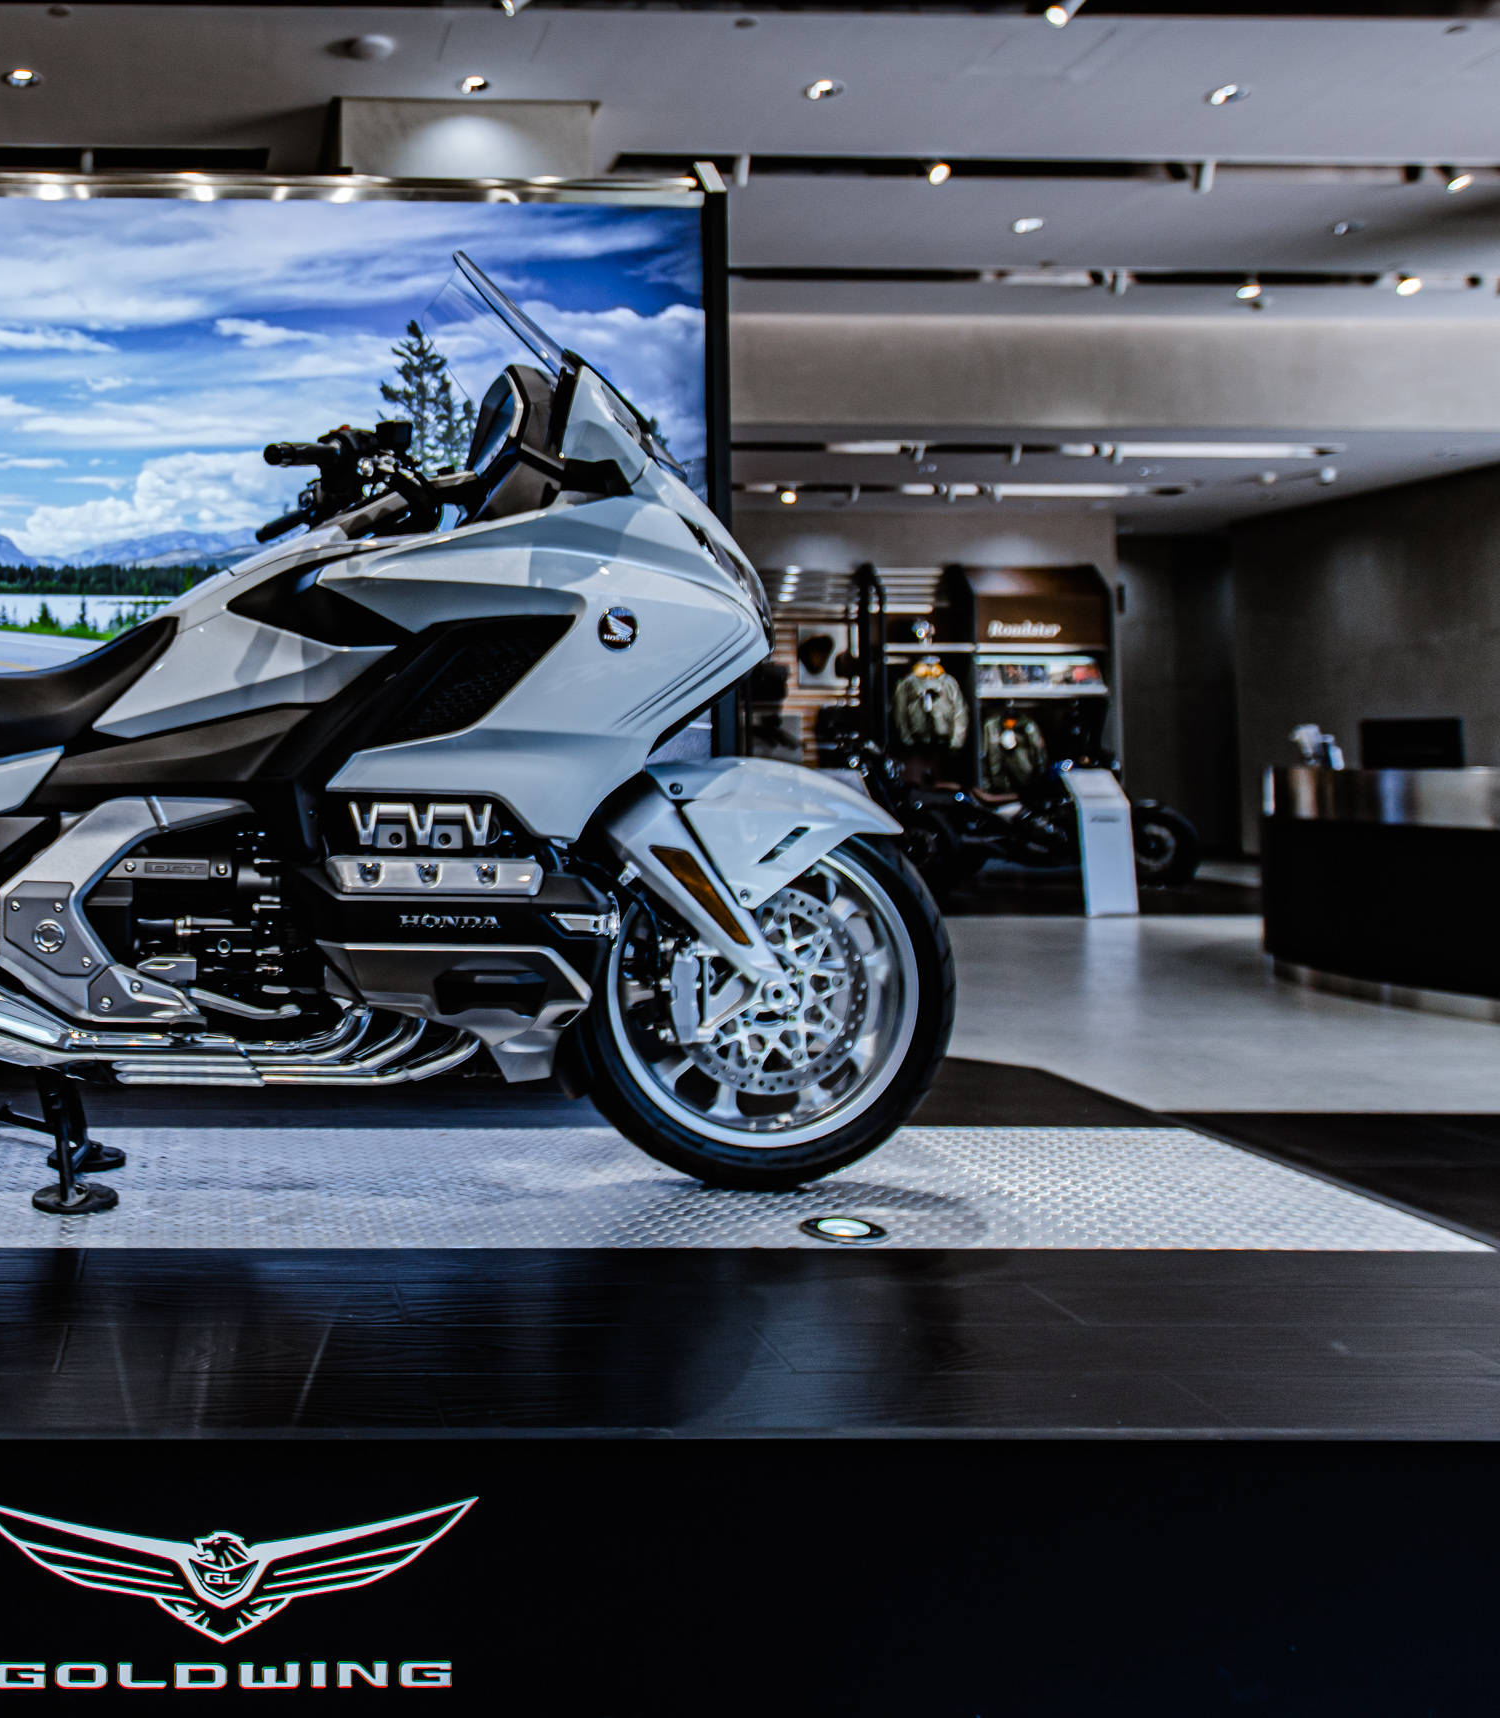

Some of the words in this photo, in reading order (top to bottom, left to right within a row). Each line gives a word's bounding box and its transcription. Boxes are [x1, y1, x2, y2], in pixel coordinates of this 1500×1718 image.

[986, 619, 1062, 639] Roadster
[399, 914, 501, 928] HONDA
[204, 1571, 241, 1585] GL
